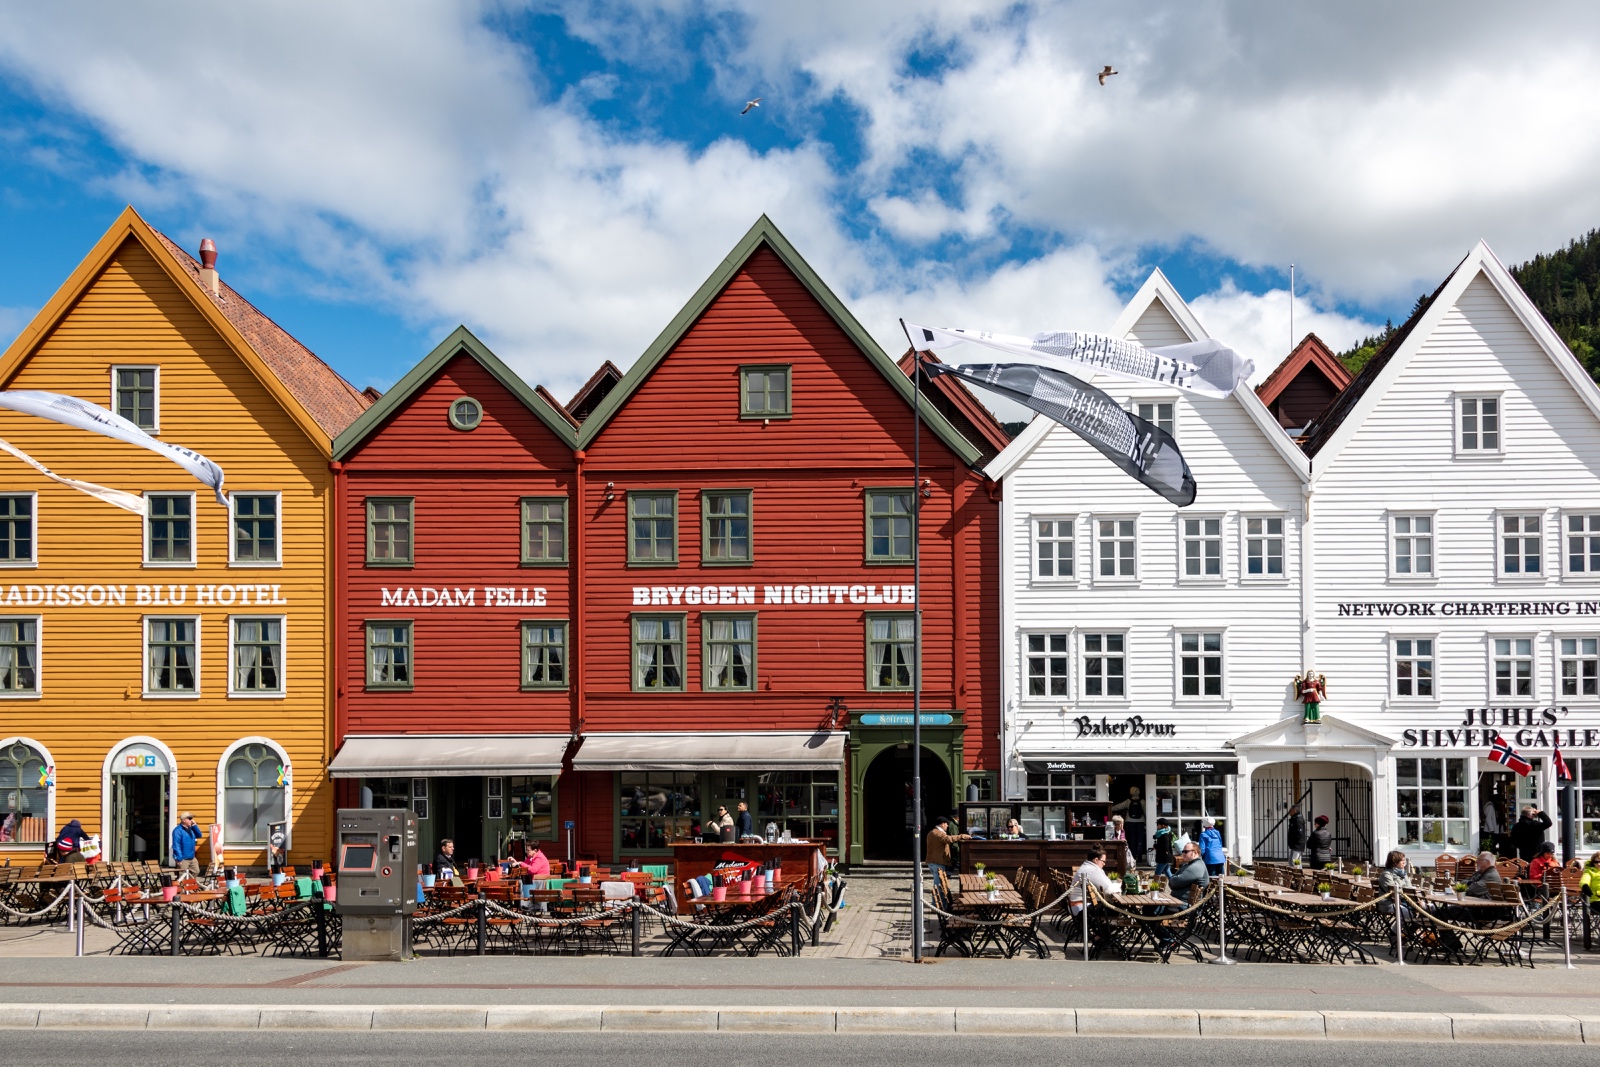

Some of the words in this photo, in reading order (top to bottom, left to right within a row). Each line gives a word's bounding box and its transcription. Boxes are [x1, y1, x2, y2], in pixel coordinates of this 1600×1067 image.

[0, 584, 128, 606] ADISSON
[135, 584, 189, 606] BLU
[195, 584, 288, 606] HOTEL
[380, 586, 476, 608] MADAM
[484, 586, 548, 608] FELLE
[632, 585, 756, 606] BRYGGEN
[763, 584, 915, 605] NIGHTCLUB
[1338, 603, 1436, 617] NETWORK
[1440, 602, 1571, 616] CHARTERING
[1576, 602, 1600, 615] IN
[1072, 714, 1177, 740] BakerBrun
[1403, 728, 1499, 748] SILVER
[1515, 728, 1600, 747] GALLE
[127, 756, 155, 767] MIX
[715, 861, 745, 869] Madam
